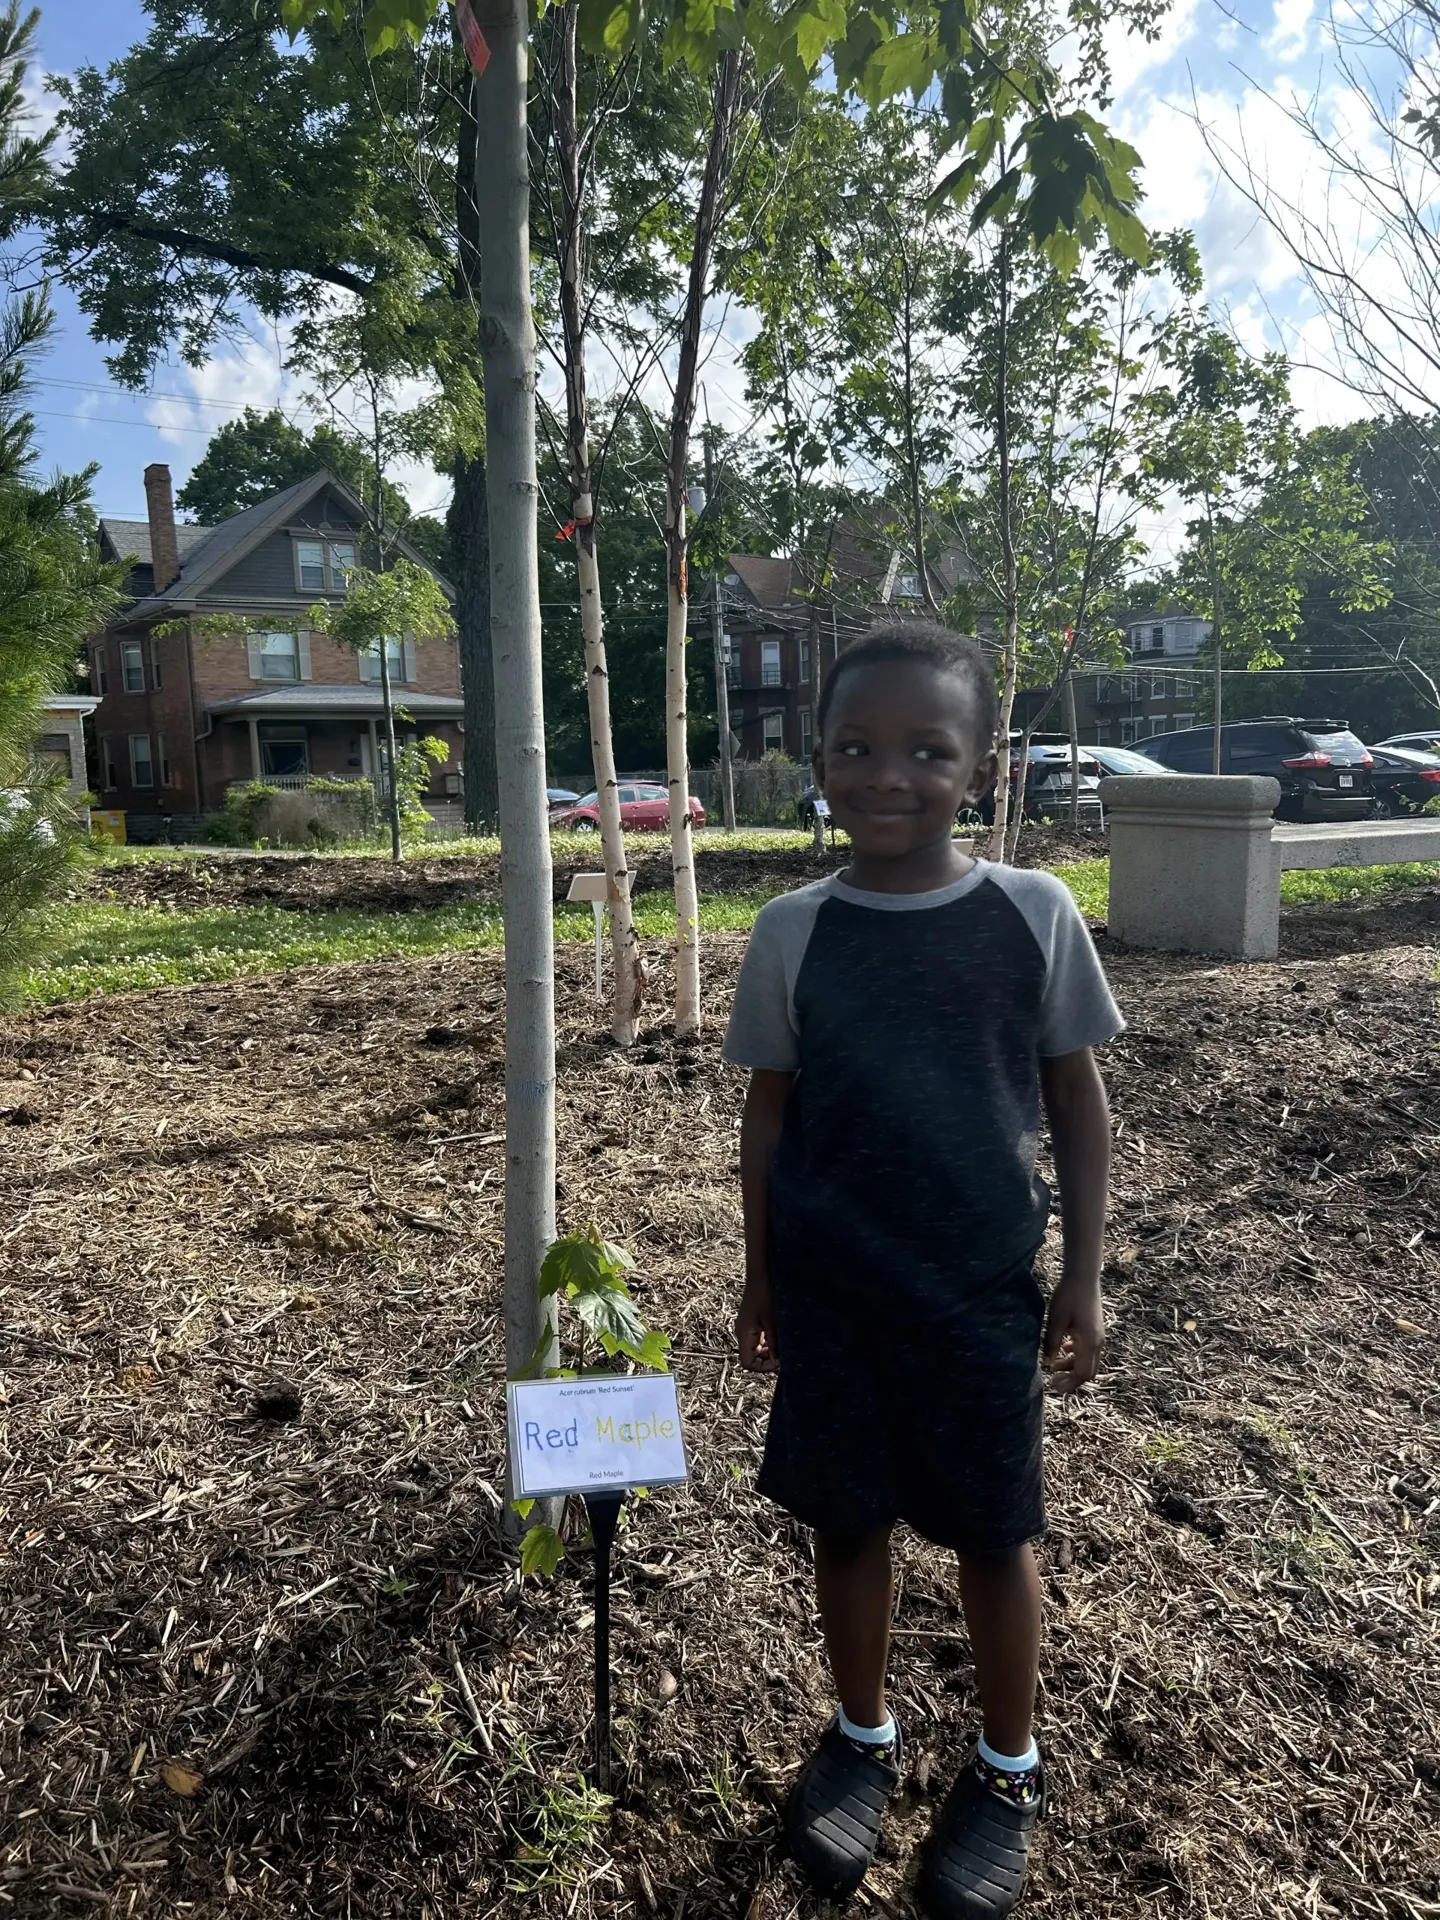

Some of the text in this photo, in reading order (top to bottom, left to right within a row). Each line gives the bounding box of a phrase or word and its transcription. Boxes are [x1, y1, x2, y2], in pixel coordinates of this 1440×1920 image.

[559, 1389, 573, 1397] Acer
[574, 1388, 596, 1396] rubrum
[525, 1412, 677, 1451] Red Maple
[589, 1469, 624, 1480] Red Maple
